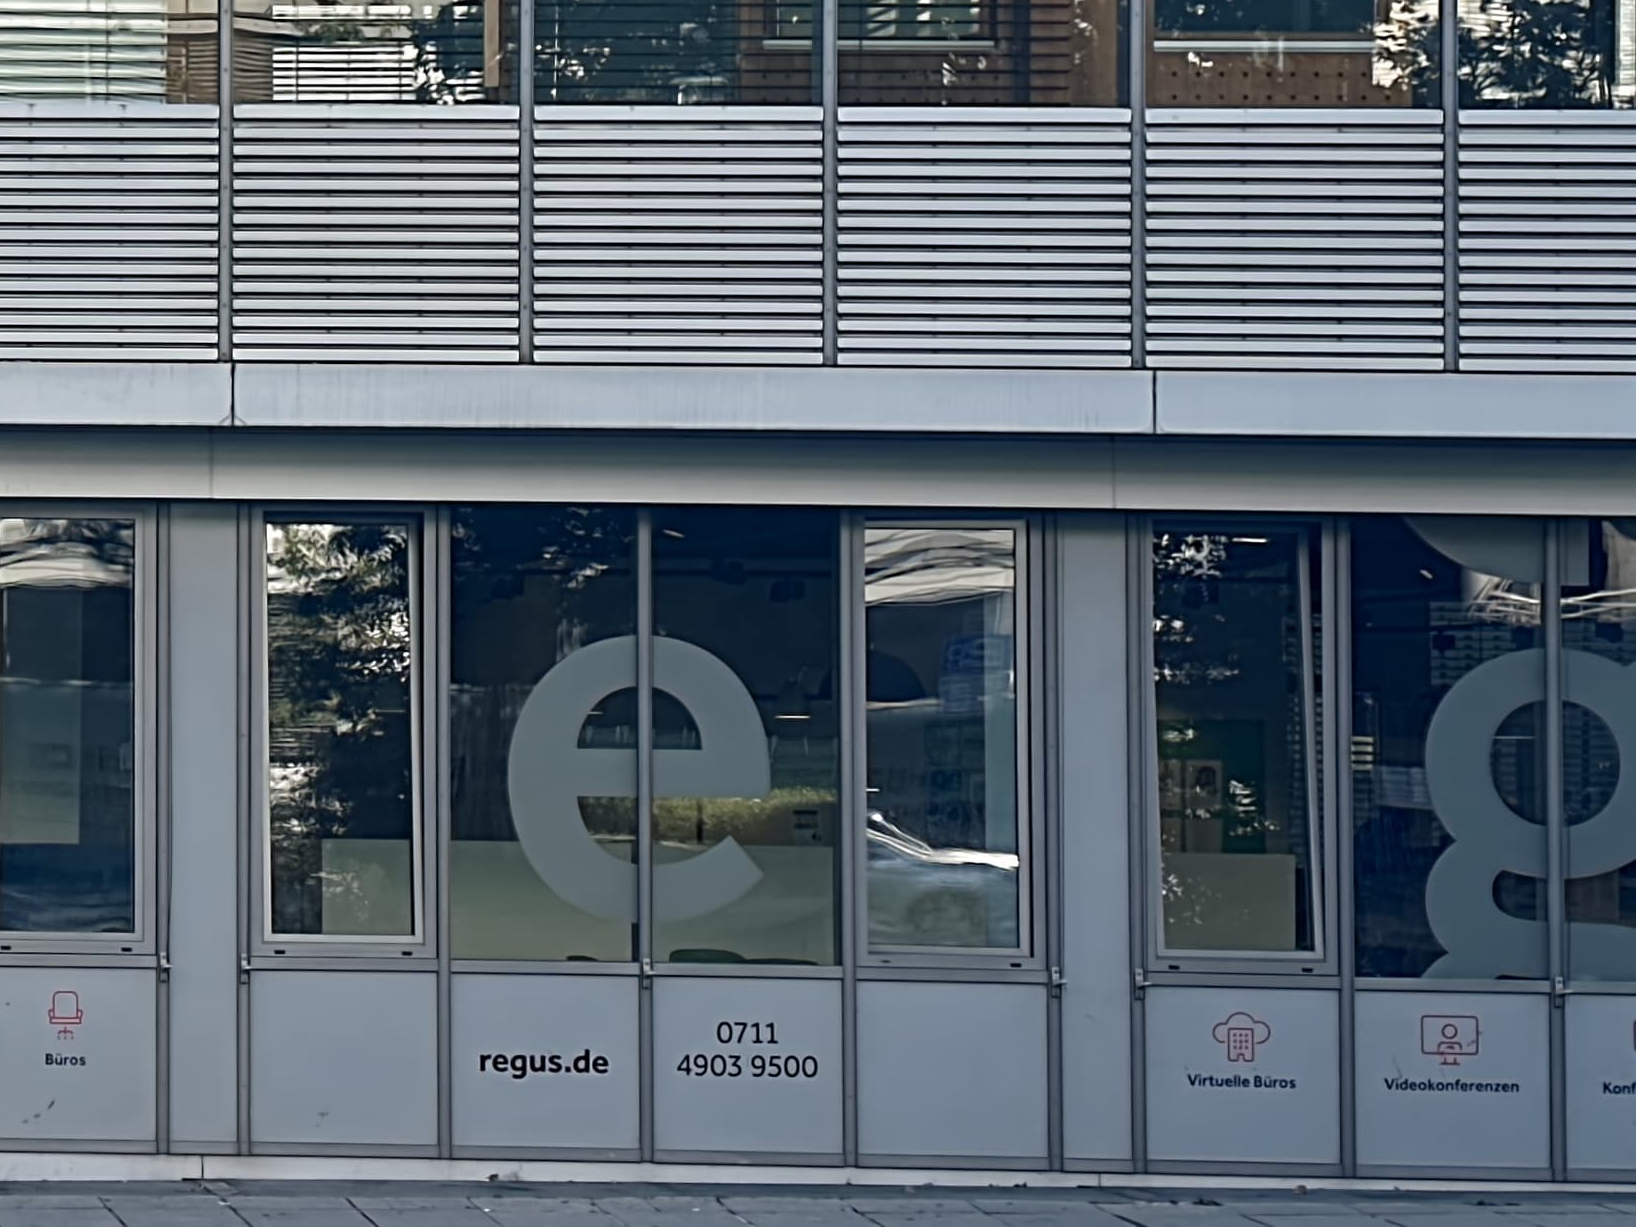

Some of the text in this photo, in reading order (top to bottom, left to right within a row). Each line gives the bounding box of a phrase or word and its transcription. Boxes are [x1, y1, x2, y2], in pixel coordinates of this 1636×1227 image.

[716, 1021, 779, 1045] 0711
[44, 1052, 87, 1067] Büros
[478, 1048, 610, 1080] regus.de
[675, 1053, 820, 1079] 4903 9500
[1187, 1073, 1297, 1090] Virtuelle Büros
[1384, 1077, 1520, 1093] Videokonferenzen
